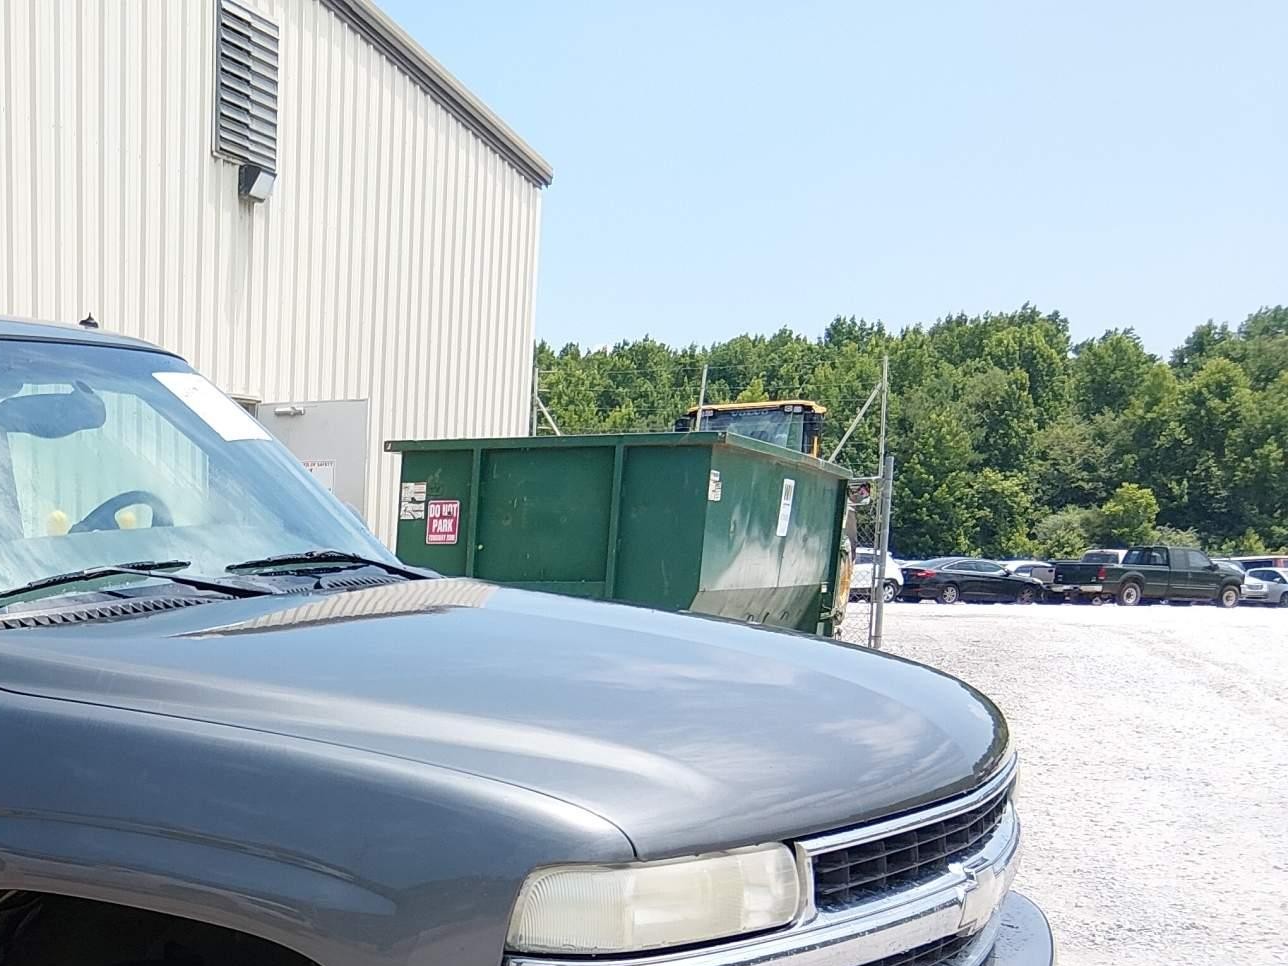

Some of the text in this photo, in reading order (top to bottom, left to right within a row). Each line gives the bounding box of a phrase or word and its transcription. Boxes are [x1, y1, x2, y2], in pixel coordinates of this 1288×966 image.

[429, 504, 441, 518] DO
[442, 503, 458, 518] NOT
[431, 518, 454, 533] PARK
